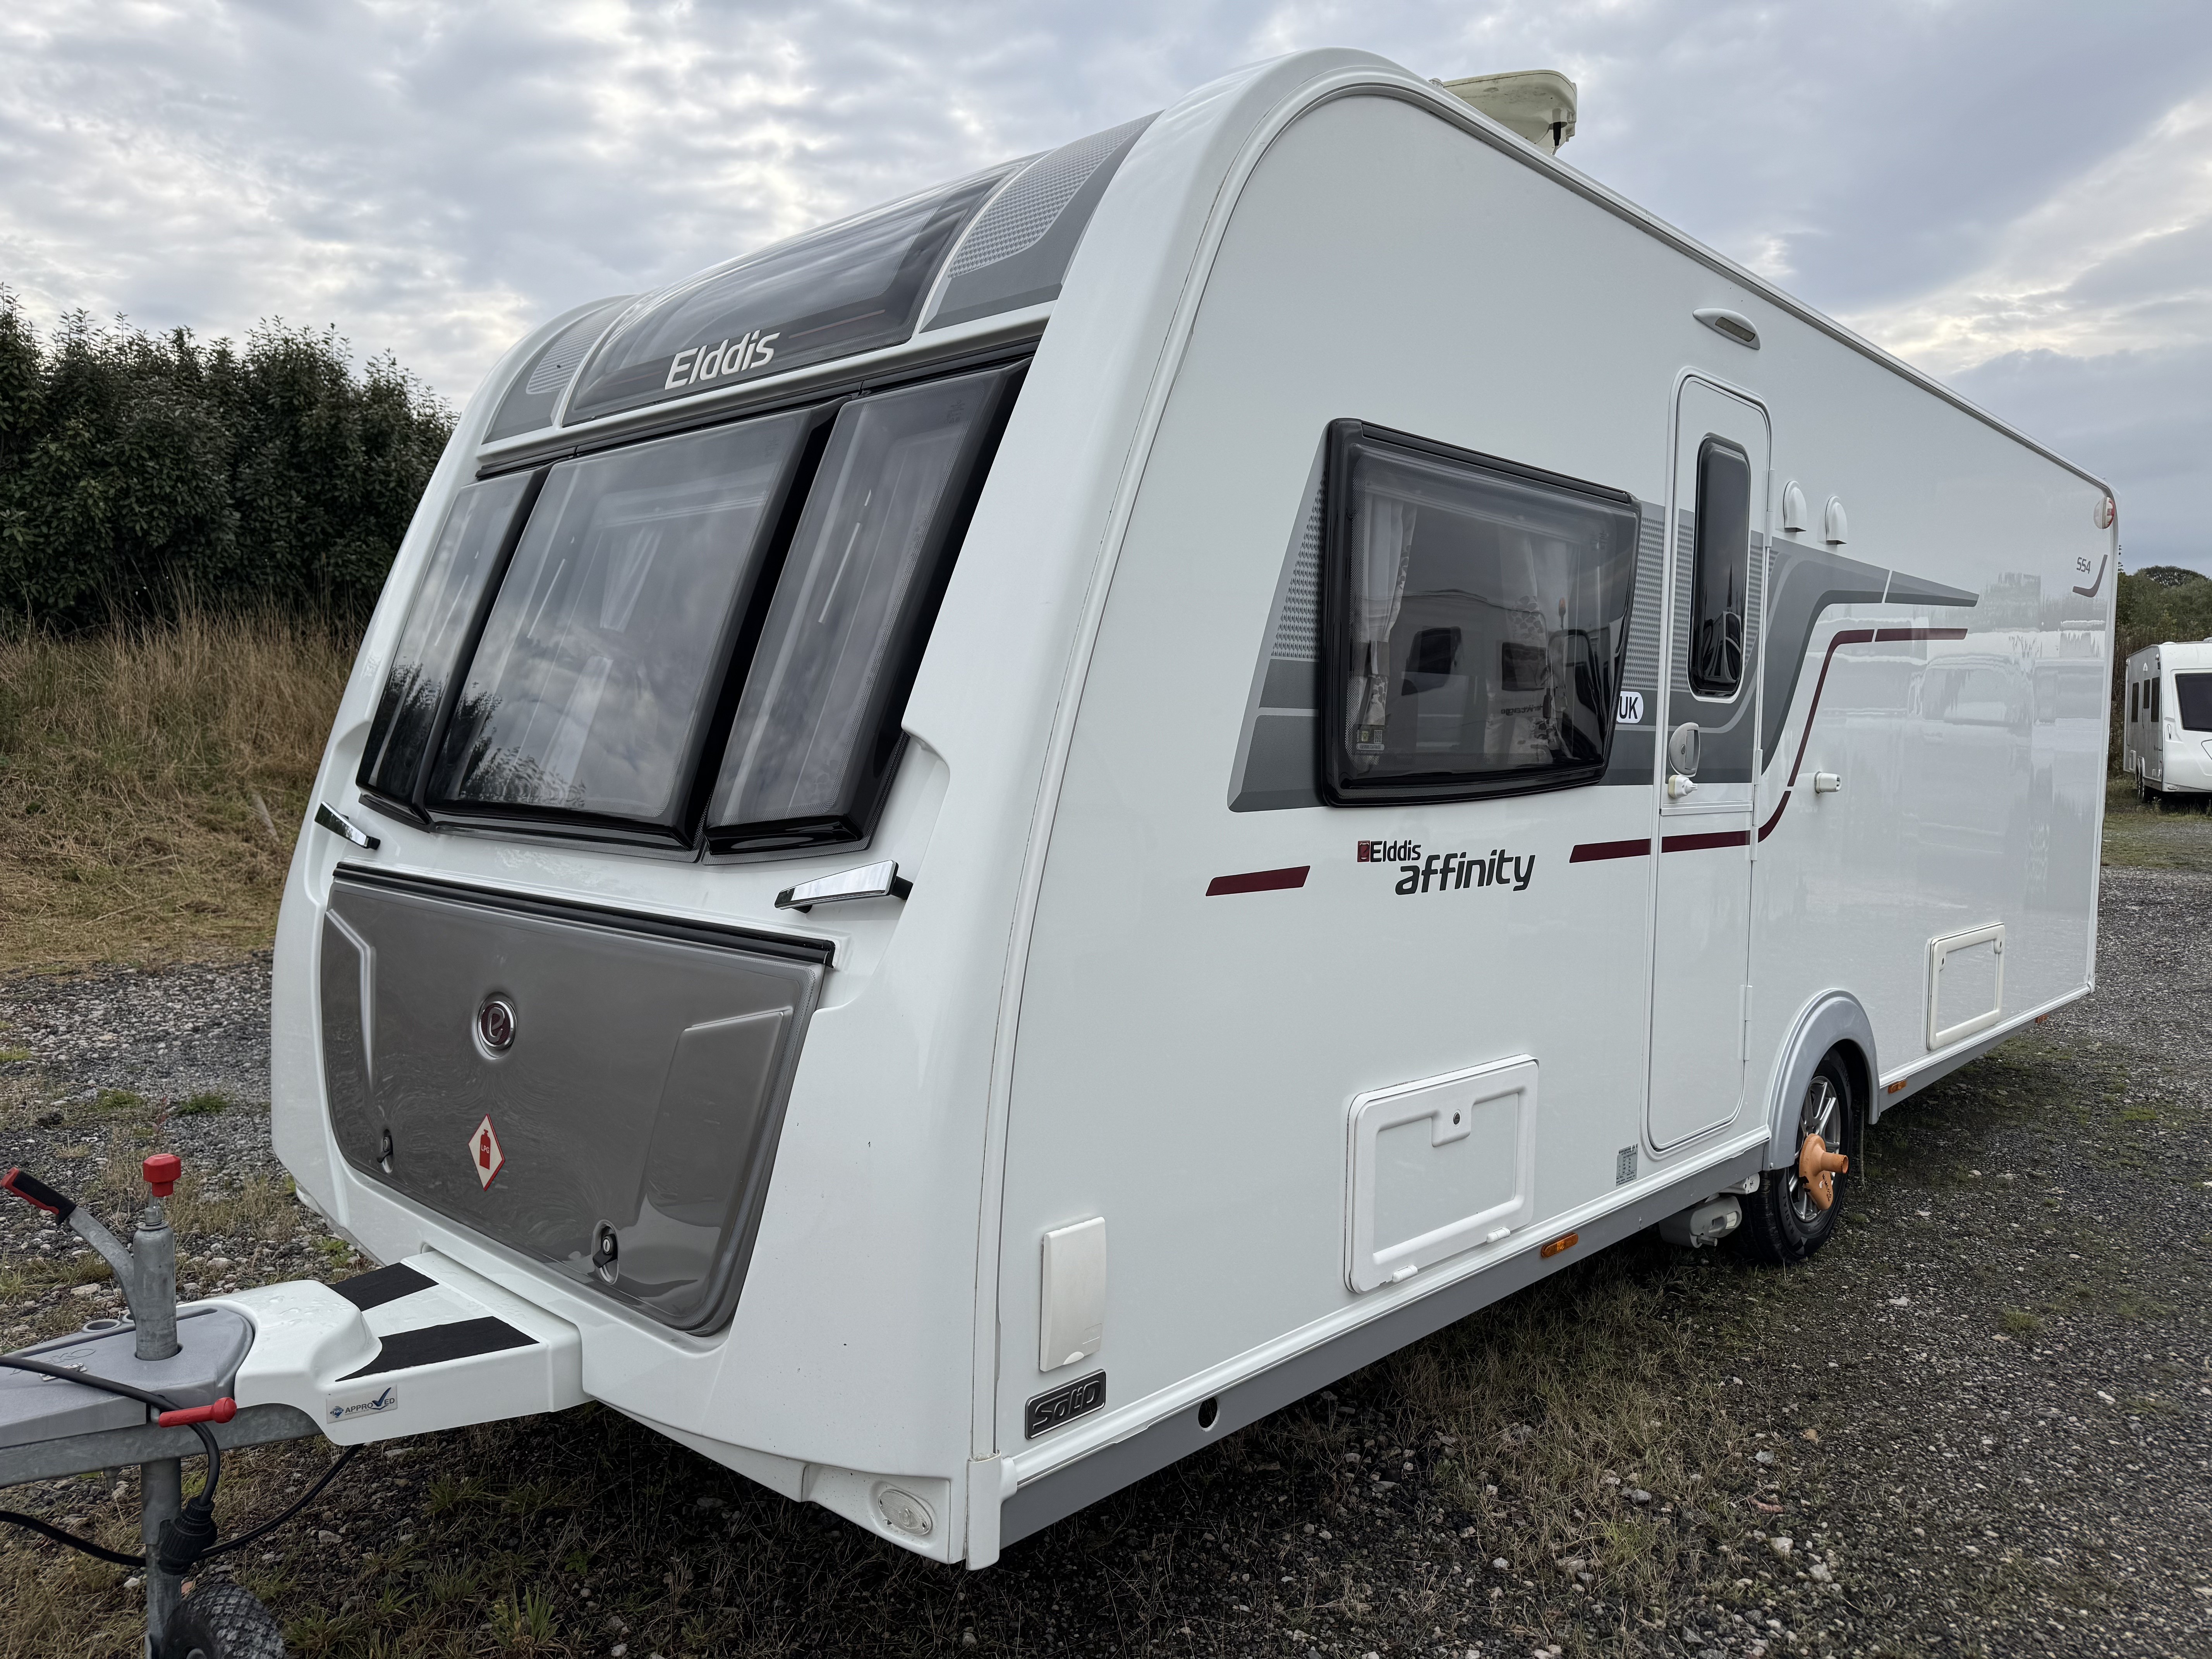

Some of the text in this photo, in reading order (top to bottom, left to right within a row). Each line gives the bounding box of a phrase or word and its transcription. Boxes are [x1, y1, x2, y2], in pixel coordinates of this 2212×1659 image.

[665, 329, 781, 390] Elddis
[2076, 556, 2091, 574] 554
[1619, 696, 1638, 719] UK
[1370, 840, 1421, 862] Elddis
[1395, 849, 1536, 895] affinity
[481, 1144, 490, 1154] LPG
